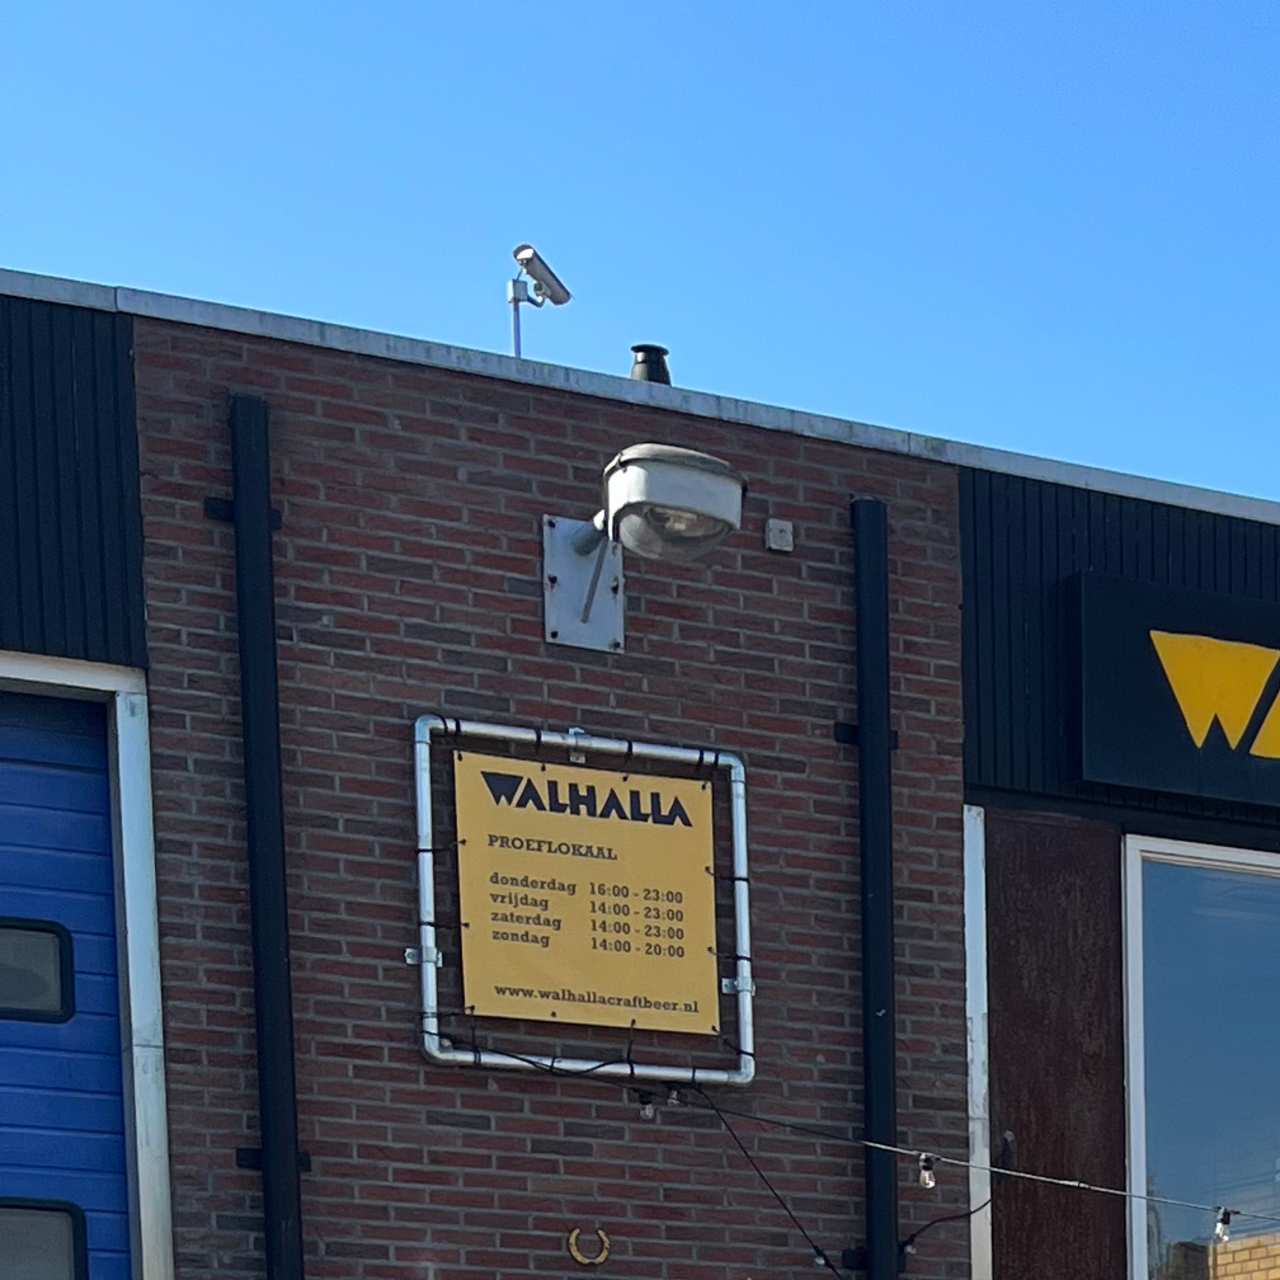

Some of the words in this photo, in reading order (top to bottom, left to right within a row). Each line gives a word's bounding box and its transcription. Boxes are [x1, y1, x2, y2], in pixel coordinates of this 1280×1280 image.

[481, 770, 693, 827] WALHALLA
[488, 833, 618, 861] PROEFLOKAAL
[490, 872, 576, 896] donderdag
[590, 882, 629, 898] 16:00
[643, 888, 683, 904] 23:00
[490, 892, 549, 911] vrijdag
[590, 901, 630, 916] 14:00
[643, 906, 684, 922] 23:00
[491, 911, 562, 931] zaterdag
[590, 919, 631, 935] 14:00
[644, 925, 684, 940] 23:00
[492, 930, 550, 948] zondag
[591, 937, 631, 953] 14:00
[645, 943, 685, 958] 20:00
[494, 983, 699, 1014] www.walhallacraftbeer.nl
